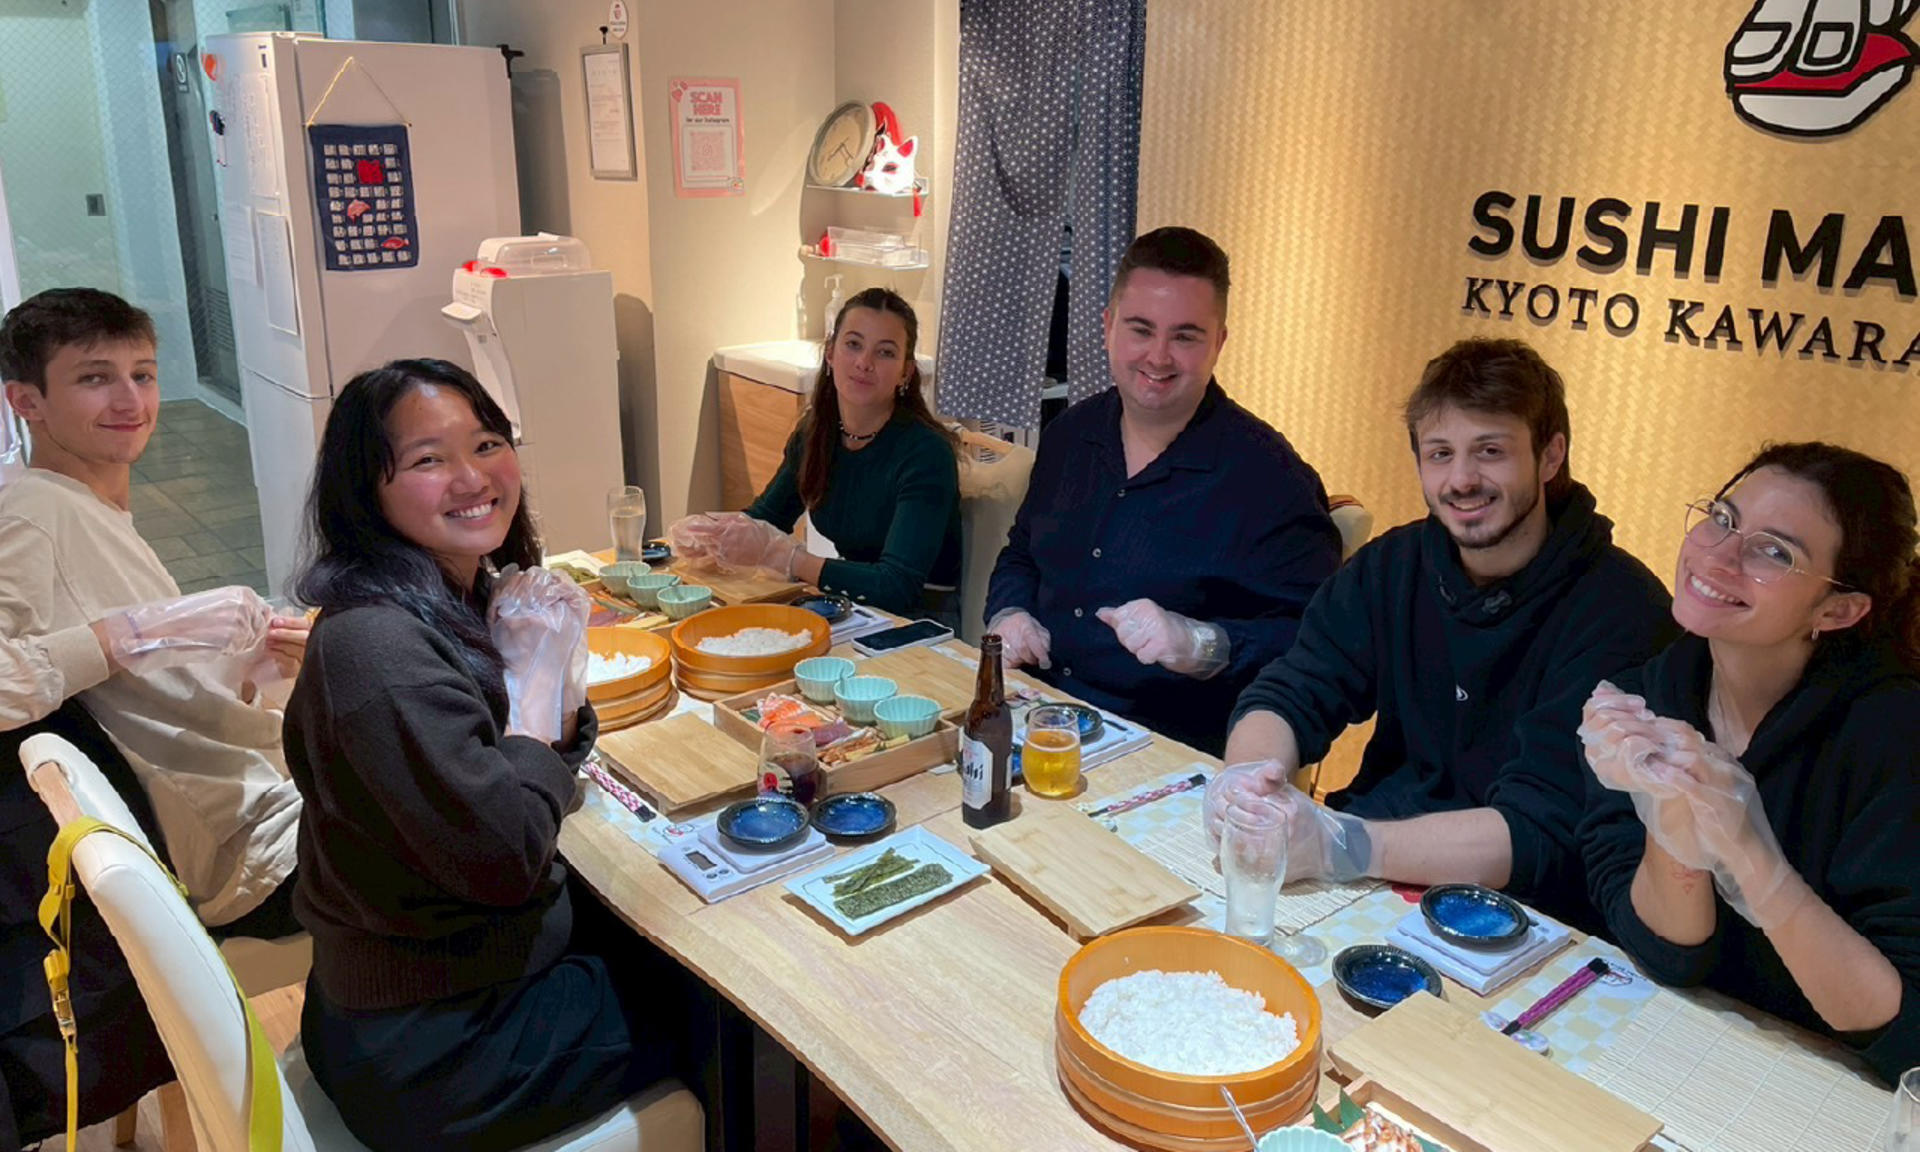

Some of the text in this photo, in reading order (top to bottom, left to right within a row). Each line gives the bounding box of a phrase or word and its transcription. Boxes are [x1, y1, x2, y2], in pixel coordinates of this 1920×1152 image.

[1468, 190, 1918, 298] SUSHI MA
[1461, 276, 1920, 366] KYOTO KAWARA
